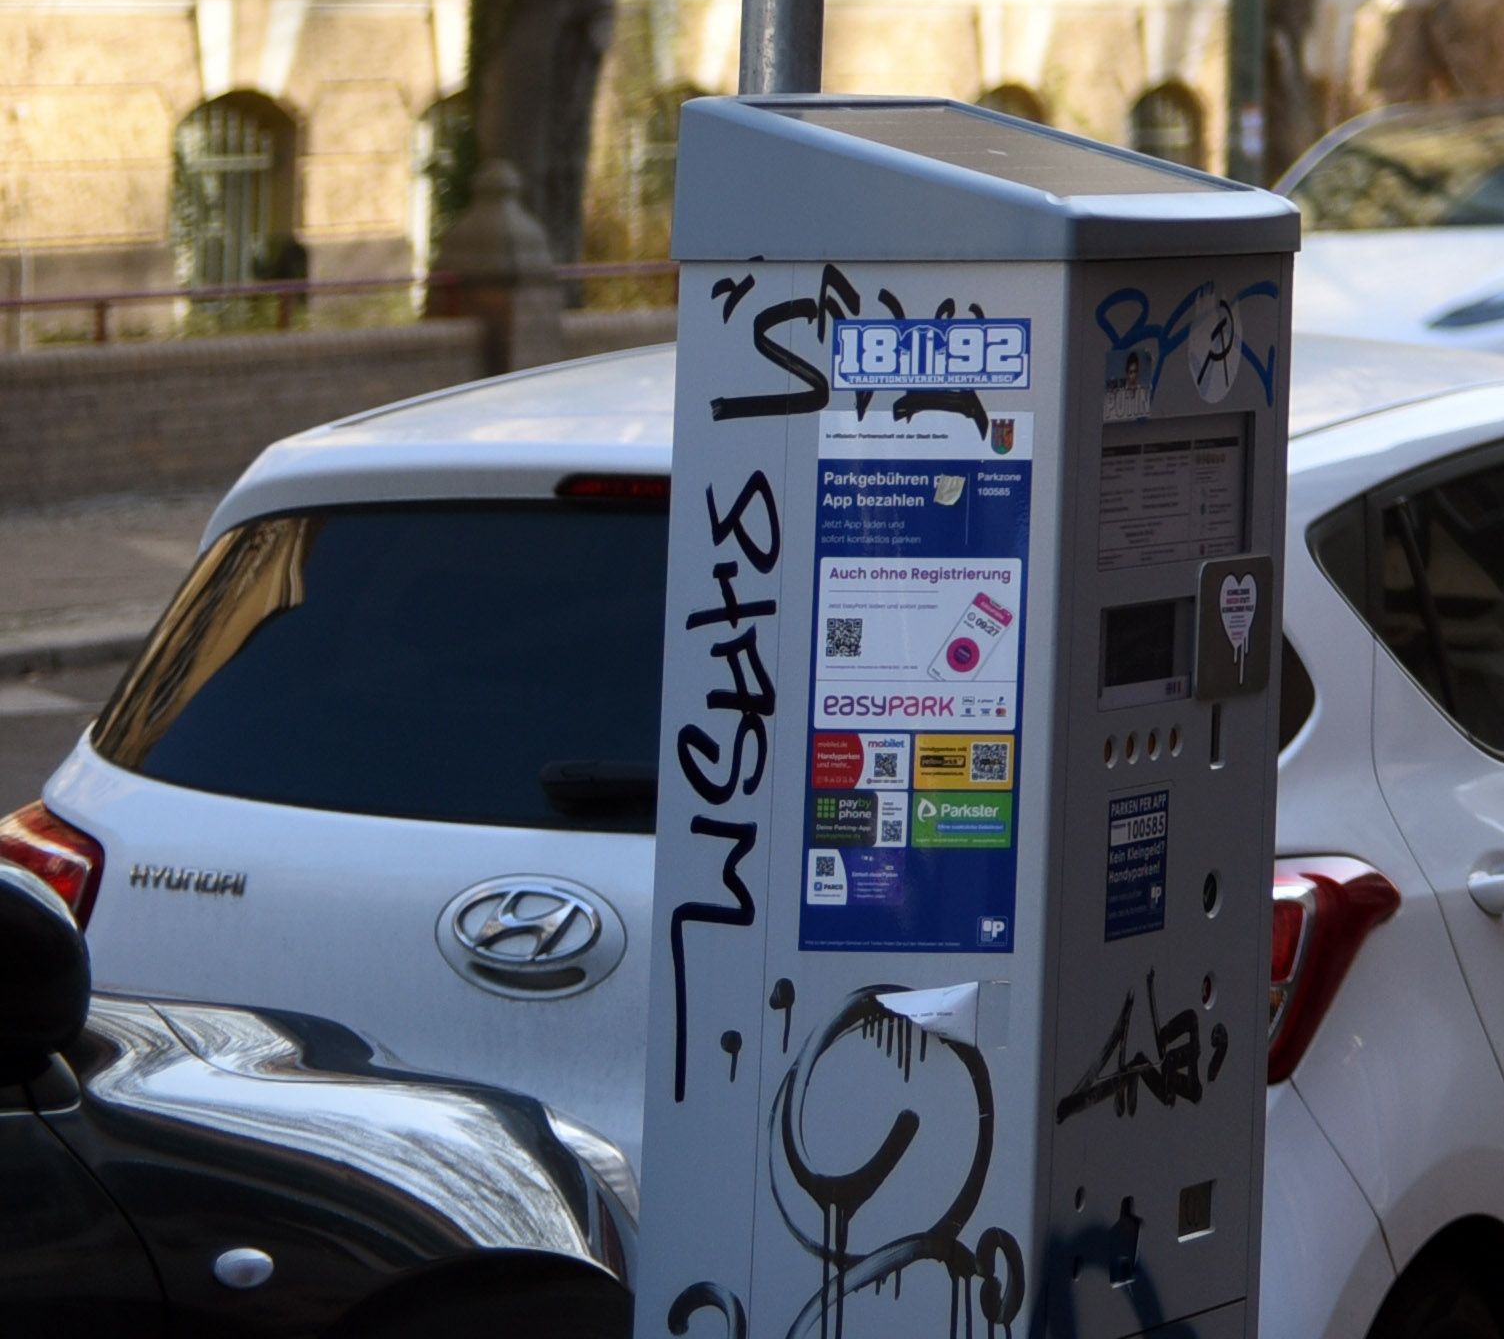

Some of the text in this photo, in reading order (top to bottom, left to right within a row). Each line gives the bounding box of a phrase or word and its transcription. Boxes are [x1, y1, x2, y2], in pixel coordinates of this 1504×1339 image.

[824, 471, 929, 488] Parkgebühren
[977, 472, 1022, 482] Parkzone
[823, 492, 925, 508] App bezahlen
[821, 519, 842, 529] Jetzt
[843, 519, 861, 531] App
[888, 520, 905, 529] und
[821, 534, 921, 545] sofort kontaktlos parken
[829, 567, 1011, 584] Auch ohne Registrierung
[868, 738, 905, 748] mobilet
[941, 803, 999, 818] Parkster
[1111, 793, 1167, 818] PARKEN PER APP
[839, 810, 872, 821] phone
[1126, 814, 1164, 841] 100585
[1109, 850, 1126, 865] Kein
[130, 863, 248, 899] HYUNDAI
